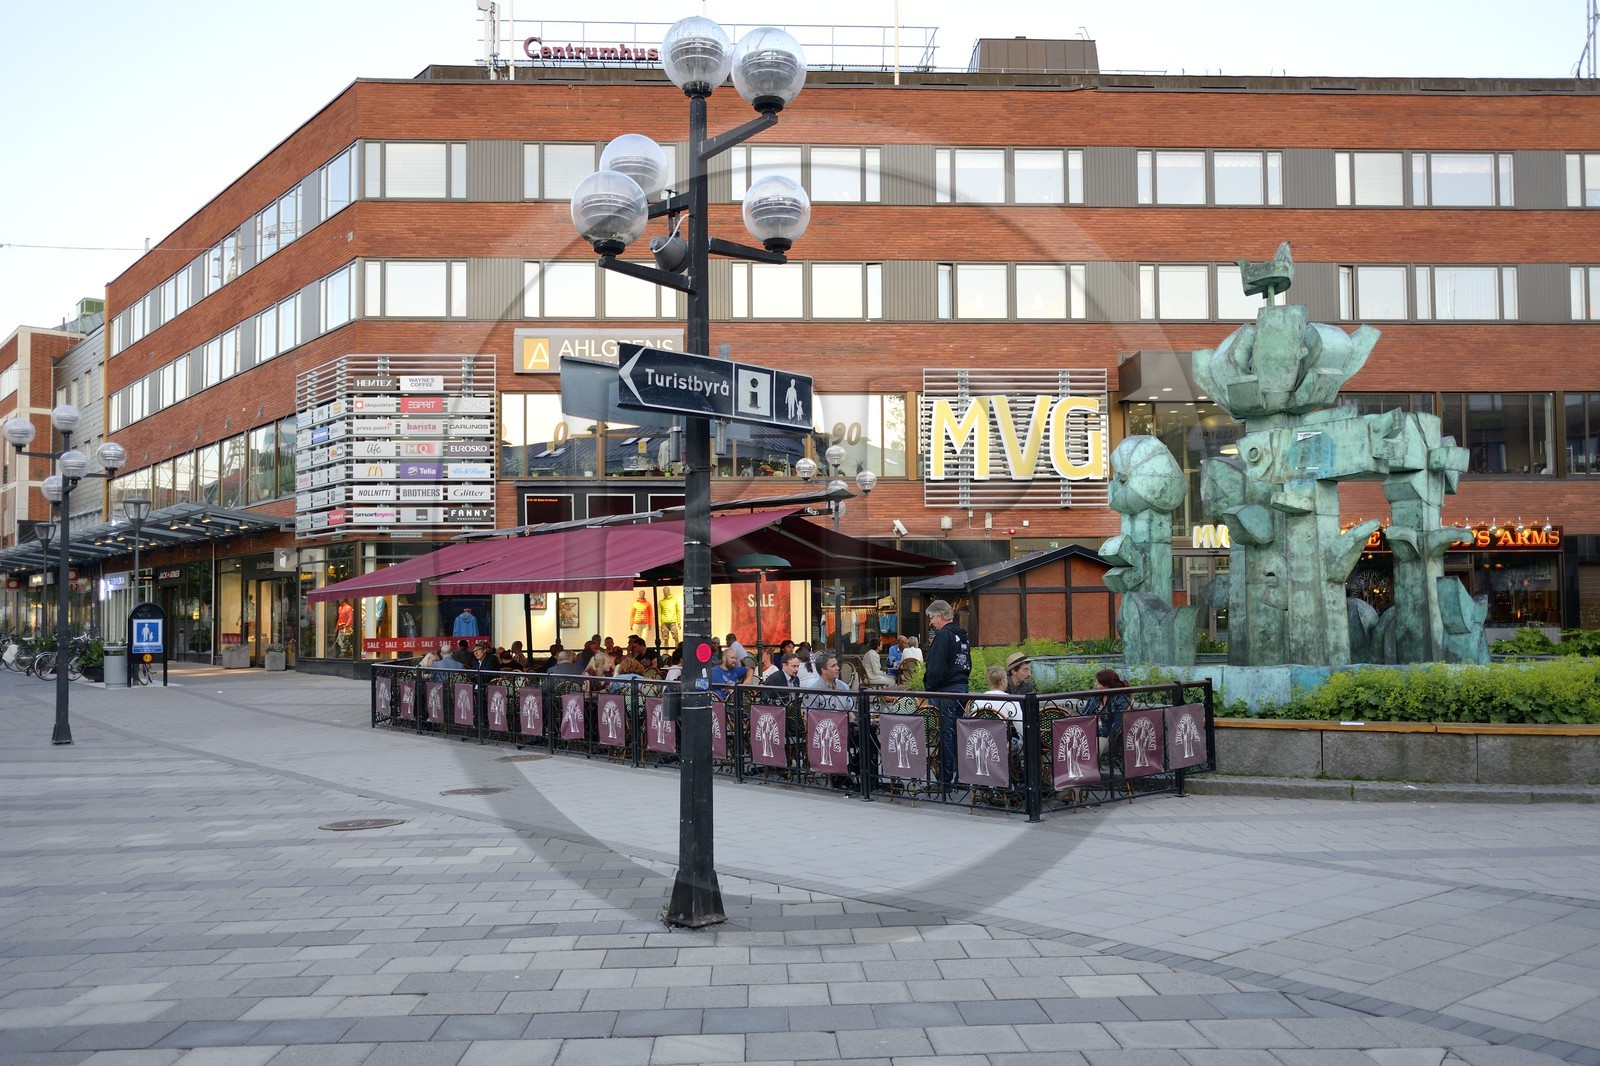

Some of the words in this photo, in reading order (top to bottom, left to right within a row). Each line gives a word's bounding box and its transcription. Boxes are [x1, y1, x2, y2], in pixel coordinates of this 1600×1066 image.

[523, 36, 659, 60] Centrumhus
[559, 340, 675, 357] AHLGNS
[356, 379, 392, 387] HEMTEX
[645, 368, 730, 397] Turistbyrå
[407, 400, 436, 409] ESPRIT
[407, 422, 437, 430] barista
[832, 422, 862, 446] 90
[930, 395, 1104, 481] MVG
[366, 443, 383, 455] life
[450, 445, 487, 453] EUROSKO
[419, 467, 437, 475] Telia
[358, 489, 391, 497] NOLLNITTI
[402, 488, 441, 497] BROTHERS
[453, 489, 486, 497] Glitter
[354, 511, 394, 519] smarteyes
[450, 509, 488, 517] FANNY
[1499, 531, 1560, 547] ARMS
[385, 641, 398, 649] SALE
[421, 640, 434, 648] SALE
